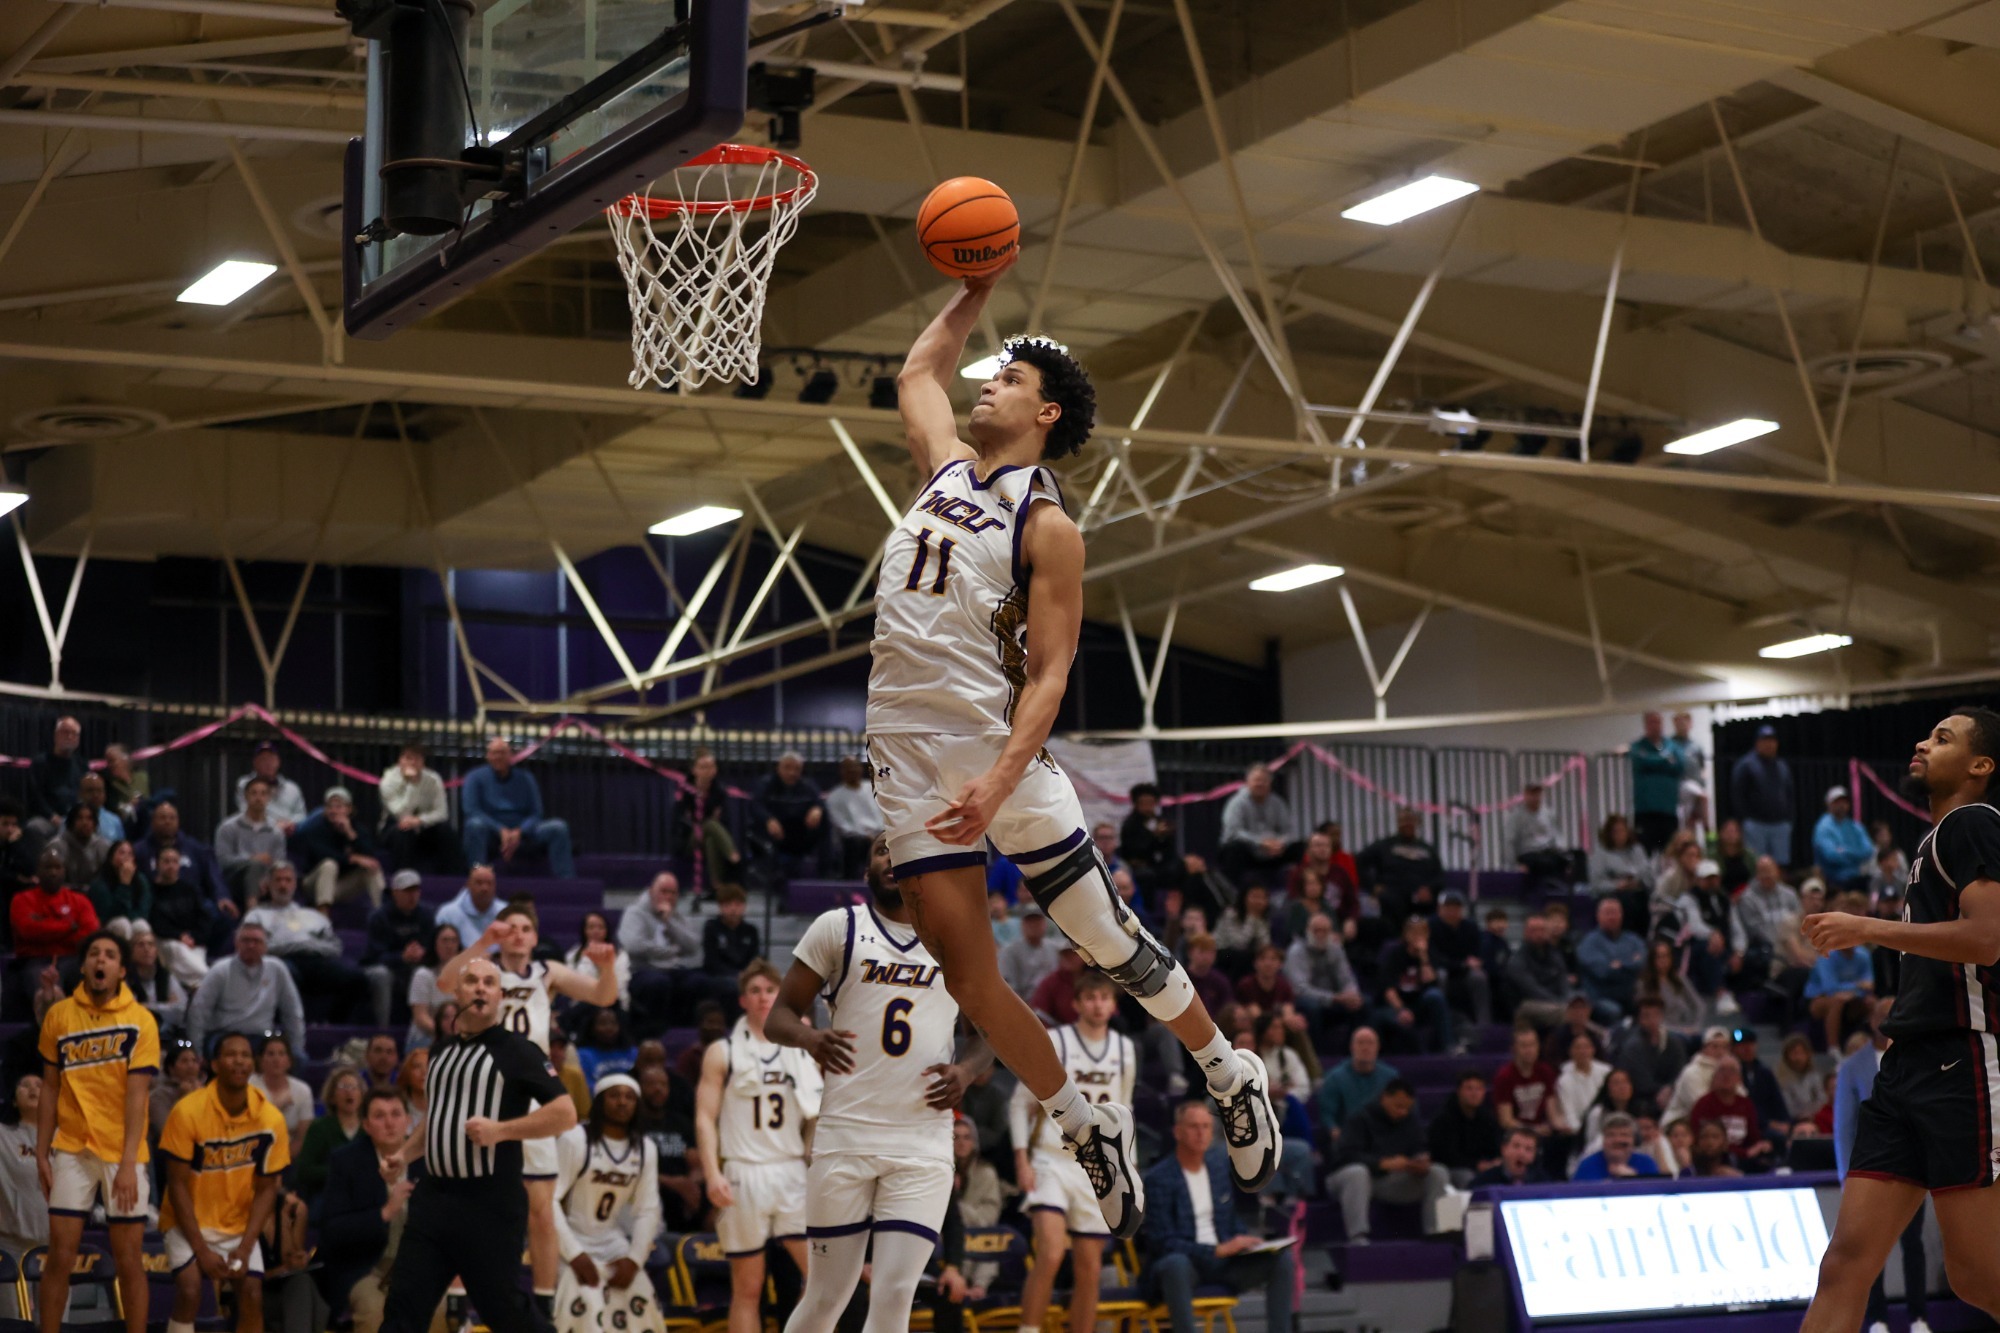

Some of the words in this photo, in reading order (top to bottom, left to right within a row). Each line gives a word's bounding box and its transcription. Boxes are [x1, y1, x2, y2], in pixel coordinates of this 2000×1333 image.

[952, 239, 1015, 264] Wilson
[916, 489, 1006, 535] WCU
[905, 526, 957, 596] 11
[861, 959, 943, 989] WCU
[881, 996, 915, 1058] 6
[61, 1031, 129, 1063] WCU
[1074, 1069, 1116, 1086] WCU
[752, 1092, 784, 1131] 13
[203, 1137, 260, 1169] WCU
[592, 1169, 637, 1188] WCU
[596, 1192, 616, 1222] 0
[1510, 1190, 1816, 1282] Fairfield
